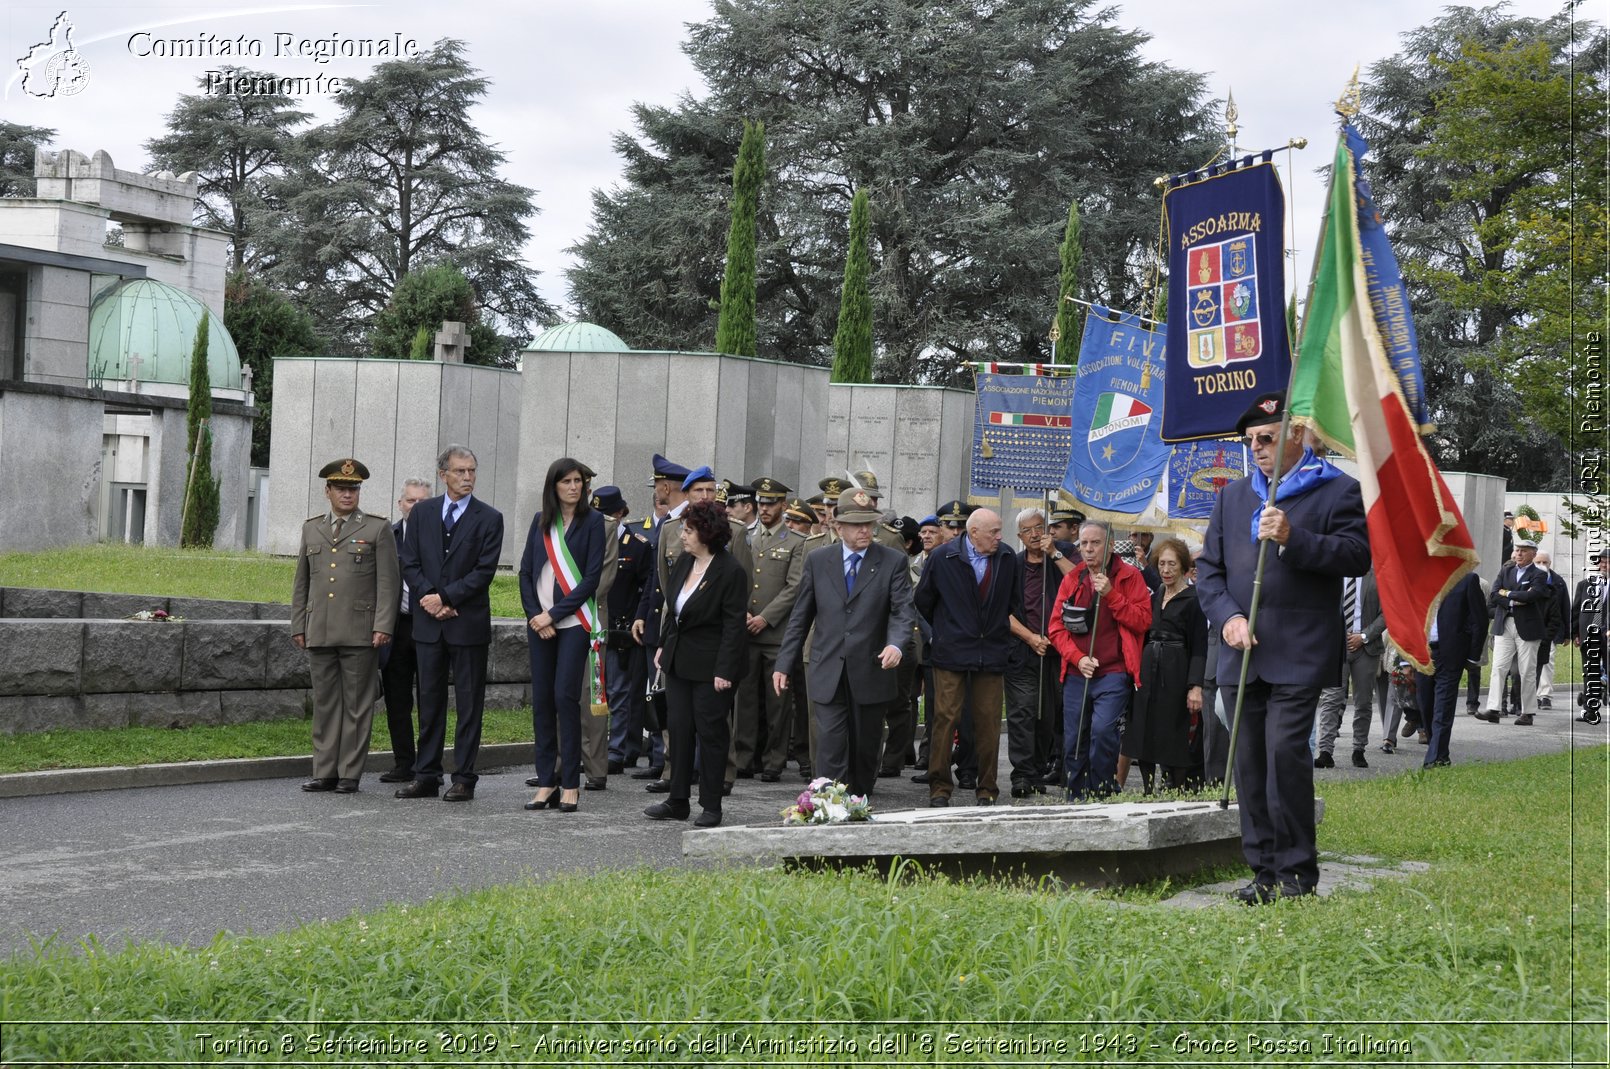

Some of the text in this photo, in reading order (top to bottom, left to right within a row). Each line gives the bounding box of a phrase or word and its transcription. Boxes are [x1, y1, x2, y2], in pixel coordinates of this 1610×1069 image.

[1181, 211, 1261, 251] ASSOARMA
[1382, 284, 1413, 355] LIBERAZIONE
[983, 385, 1030, 395] ASSOCIAZIONE
[1030, 388, 1068, 397] NAZIONALE
[1193, 368, 1257, 395] TORINO
[1090, 416, 1144, 440] AUTONOMI
[1107, 477, 1152, 502] TORINO
[1188, 492, 1204, 500] SEDE
